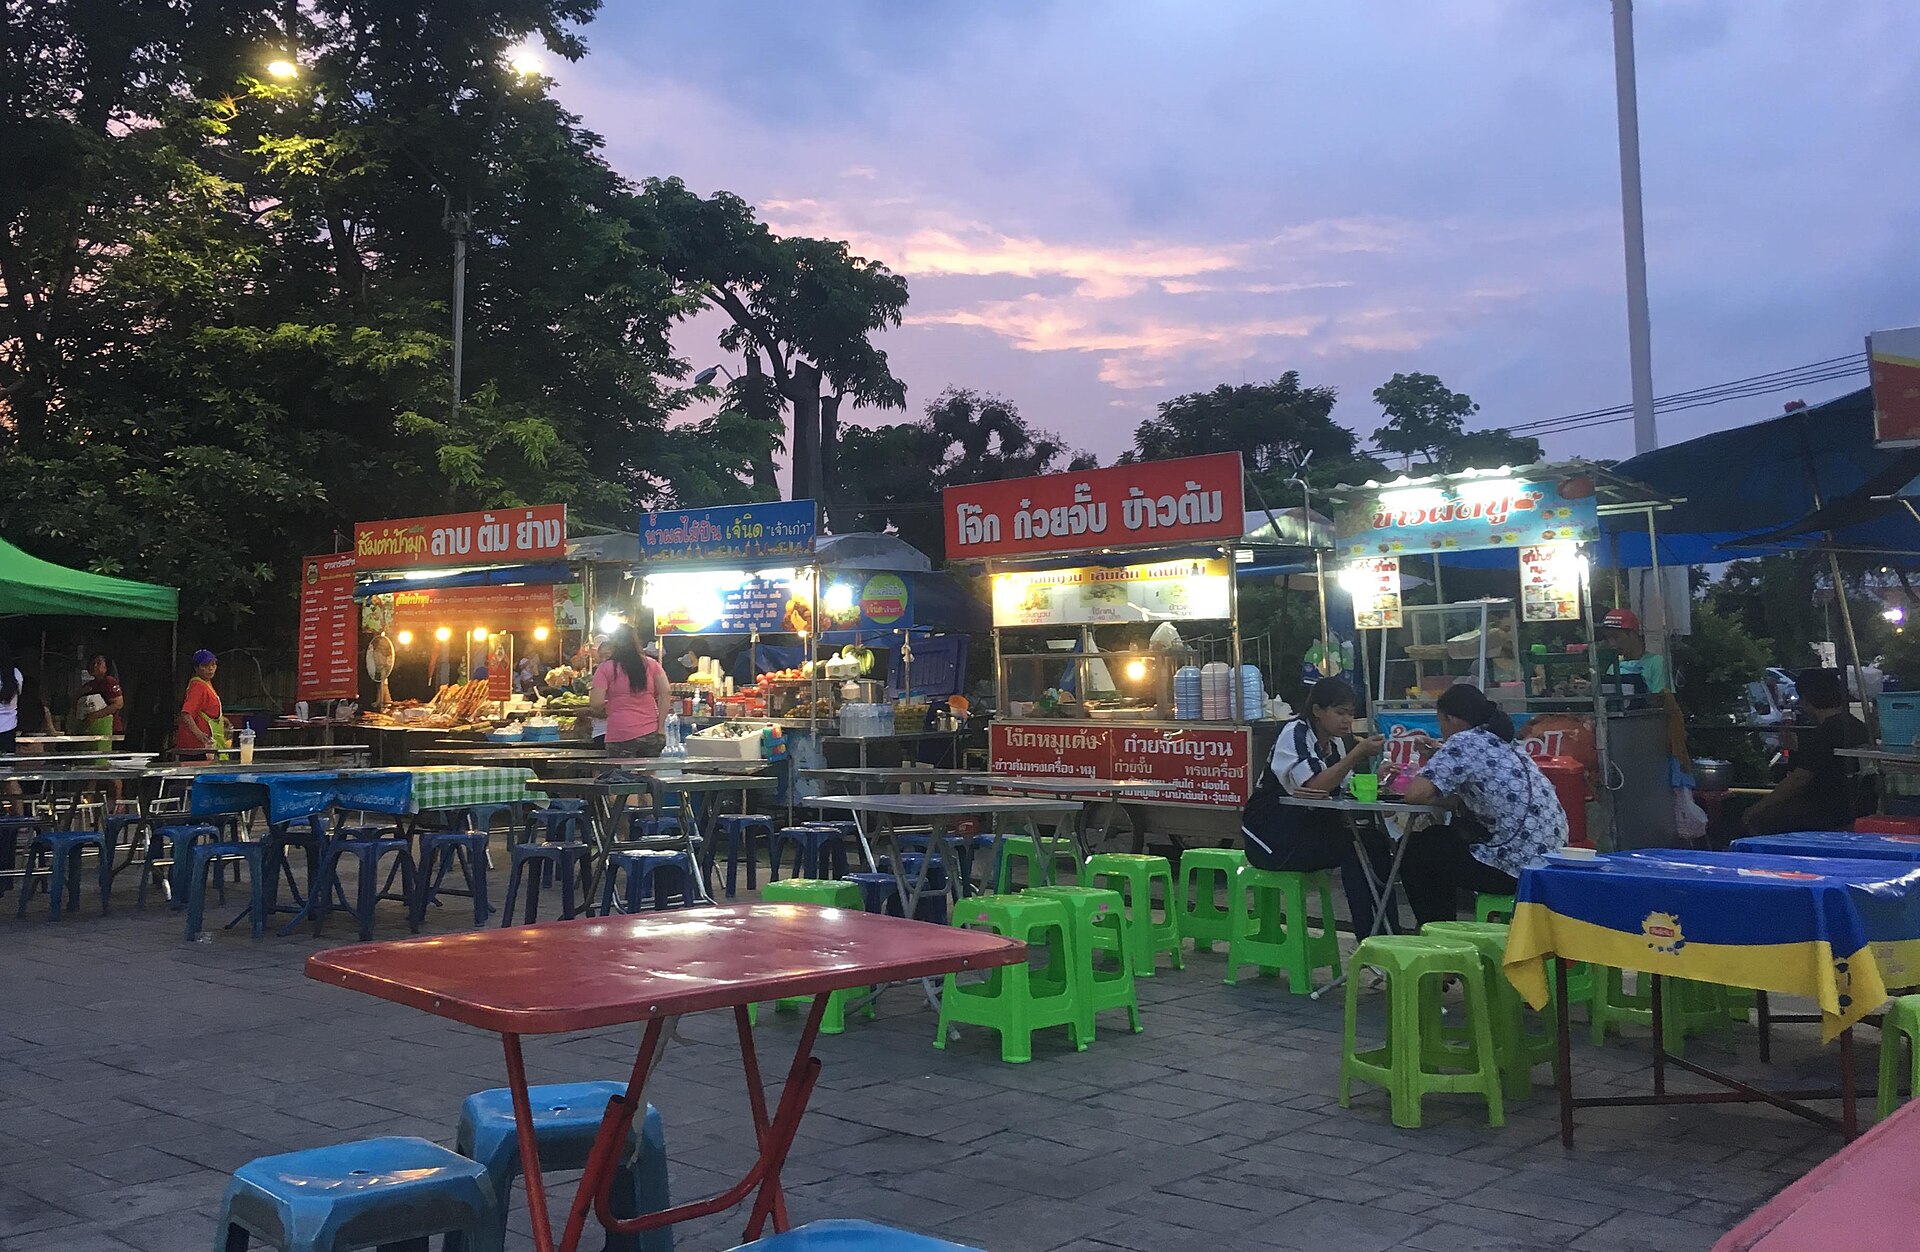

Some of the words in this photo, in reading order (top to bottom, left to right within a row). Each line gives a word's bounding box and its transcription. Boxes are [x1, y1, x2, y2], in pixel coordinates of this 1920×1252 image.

[644, 512, 722, 546] น้ำผลไม้ปั่น
[726, 512, 763, 540] เจ้นิด
[957, 503, 1000, 545] โจ๊ก
[1014, 482, 1107, 540] ก๋วยจั๊บ
[1122, 480, 1222, 530] ข้าวต้ม
[431, 526, 471, 556] ลาบ
[477, 514, 510, 553] ต้ม
[516, 511, 561, 550] ย่าง
[1080, 765, 1096, 780] หมู
[1184, 759, 1244, 778] ทรงเครื่อง
